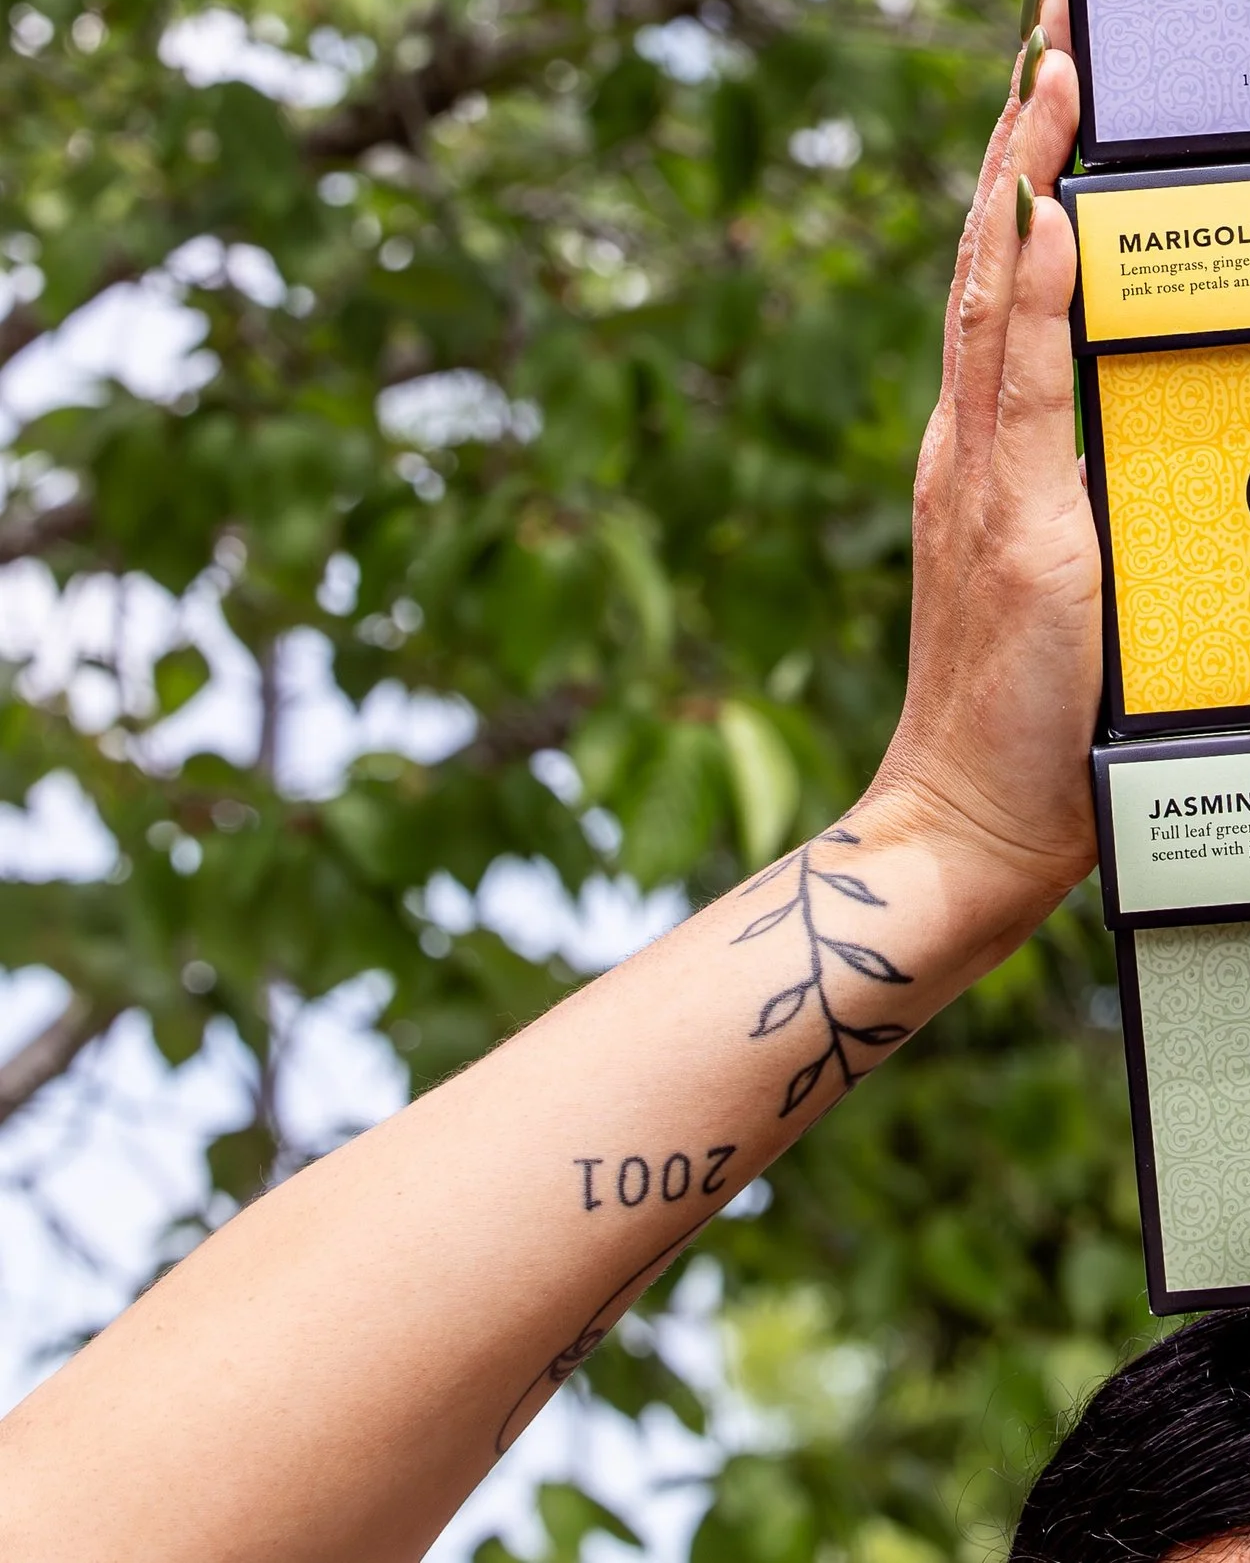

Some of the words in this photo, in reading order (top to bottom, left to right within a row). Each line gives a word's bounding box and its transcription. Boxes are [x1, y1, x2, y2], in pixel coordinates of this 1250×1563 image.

[1120, 260, 1209, 280] Lemongrass,
[1122, 282, 1152, 300] pink
[1157, 284, 1184, 293] rose
[1190, 276, 1229, 294] petals
[1151, 825, 1179, 840] Full
[1185, 824, 1211, 837] leaf
[1152, 844, 1206, 861] scented
[1212, 841, 1243, 856] with
[573, 1144, 737, 1212] 2001
